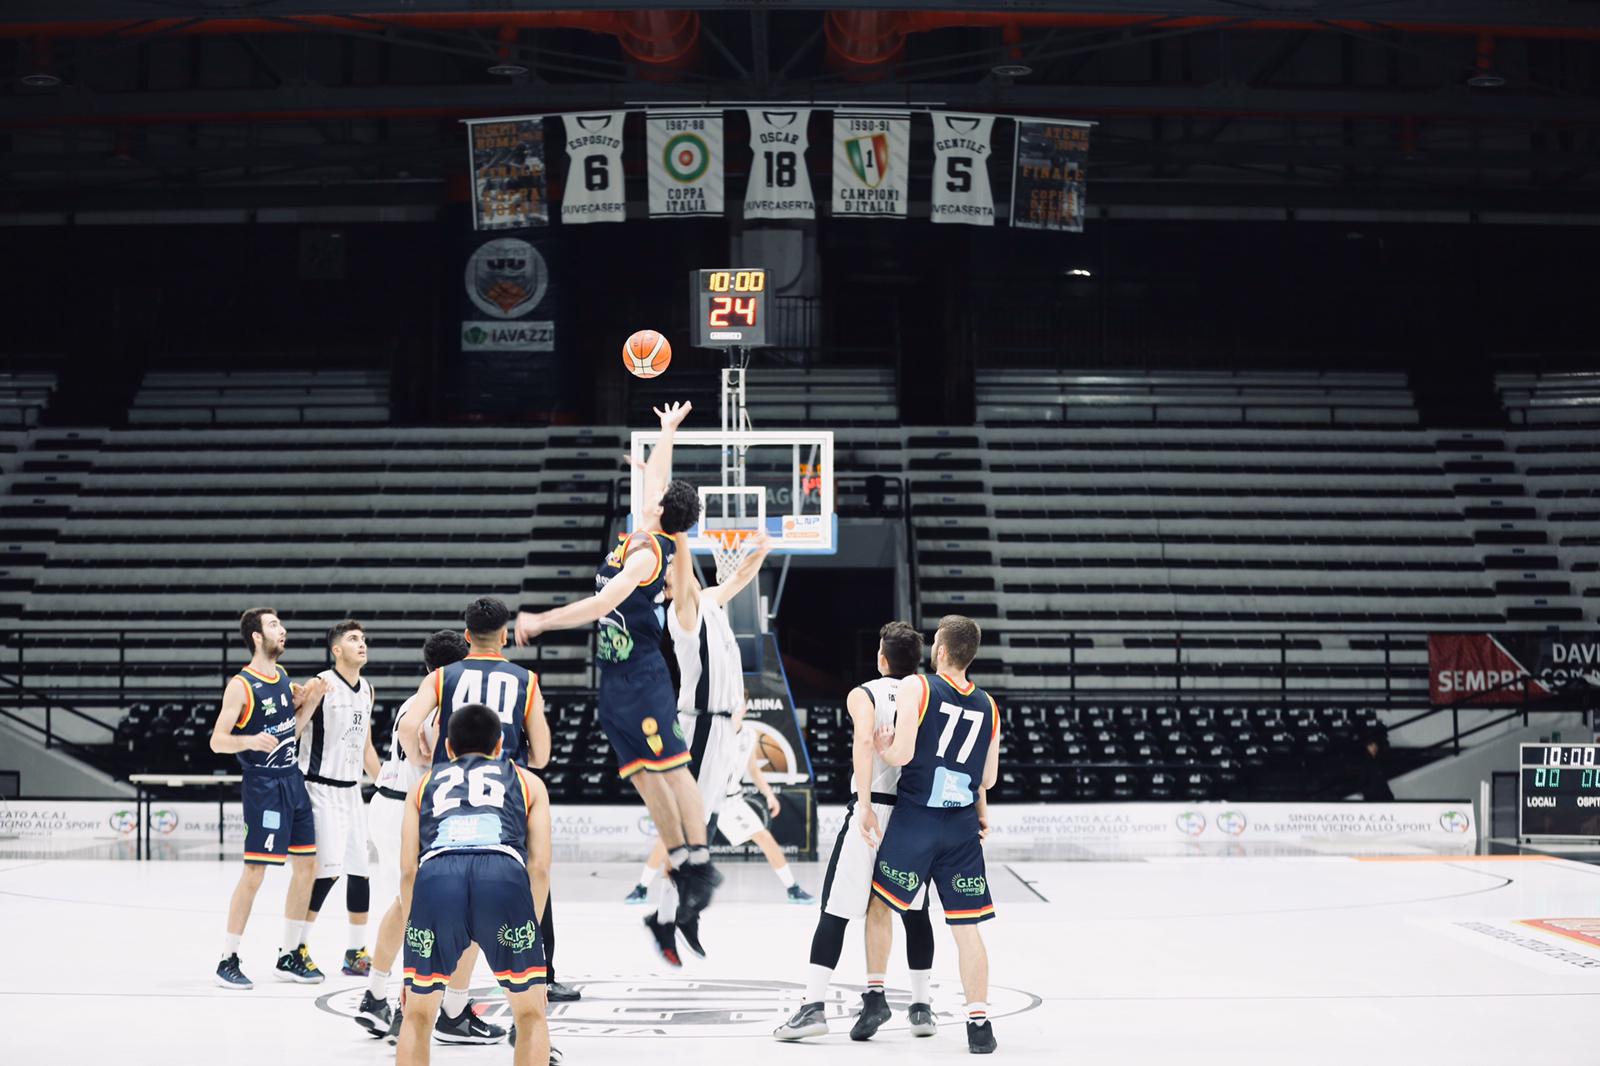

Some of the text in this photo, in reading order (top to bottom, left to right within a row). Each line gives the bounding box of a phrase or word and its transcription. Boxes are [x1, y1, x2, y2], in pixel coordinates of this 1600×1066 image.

[665, 120, 705, 131] 1987-88
[568, 135, 621, 150] ESPOSITO
[759, 132, 799, 144] OSCAR
[936, 138, 986, 154] GENTILE
[866, 149, 874, 169] 1
[584, 154, 609, 191] 6
[764, 151, 797, 188] 18
[946, 156, 973, 192] 5
[1022, 164, 1085, 183] FINALE
[666, 188, 706, 200] COPPA
[840, 188, 900, 201] CAMPIONI
[665, 200, 707, 212] ITALIA
[709, 271, 765, 292] 10:00
[709, 297, 756, 327] 24
[280, 693, 289, 708] 4
[451, 668, 519, 725] 40
[935, 700, 985, 765] 77
[1544, 747, 1596, 767] 10:00
[432, 764, 507, 819] 26
[1526, 796, 1557, 808] LOCALI
[1021, 815, 1090, 824] SINDACATO
[1288, 813, 1355, 822] SINDACATO
[36, 820, 63, 830] ALLO
[66, 820, 101, 831] SPORT
[184, 822, 200, 831] DA
[593, 825, 629, 834] SPORT
[1007, 825, 1053, 833] SEMPRE
[1055, 824, 1097, 833] VICINO
[1099, 824, 1130, 833] ALLO
[1132, 824, 1167, 832] SPORT
[1254, 823, 1432, 832] DA SEMPRE VICINO ALLO SPORT
[264, 833, 275, 852] 4
